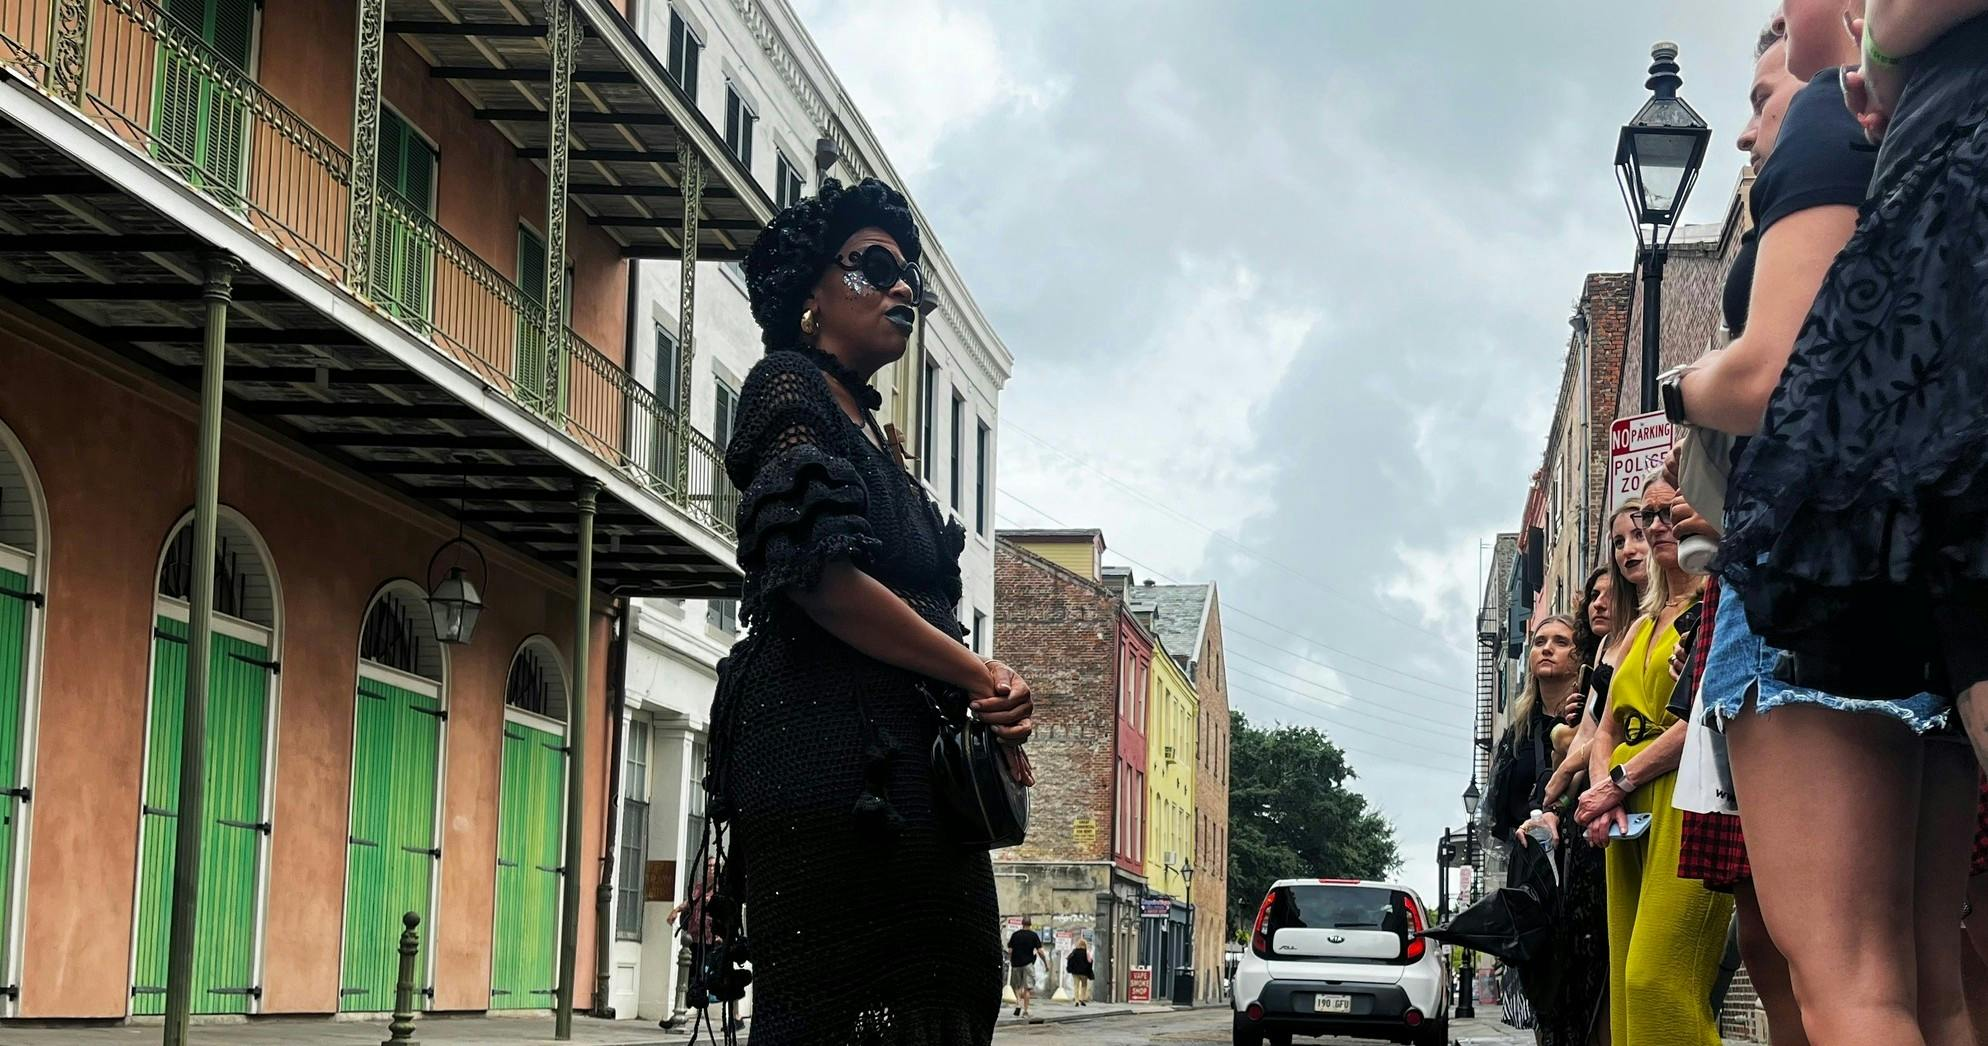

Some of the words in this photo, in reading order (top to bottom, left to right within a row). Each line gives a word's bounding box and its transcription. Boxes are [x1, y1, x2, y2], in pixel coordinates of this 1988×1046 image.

[1612, 428, 1629, 450] NO
[1631, 423, 1670, 443] PARKING
[1621, 476, 1640, 493] ZO
[1133, 972, 1148, 980] VAPE
[1131, 987, 1148, 996] SHOP
[1317, 998, 1331, 1008] 190
[1335, 999, 1349, 1009] GFU
